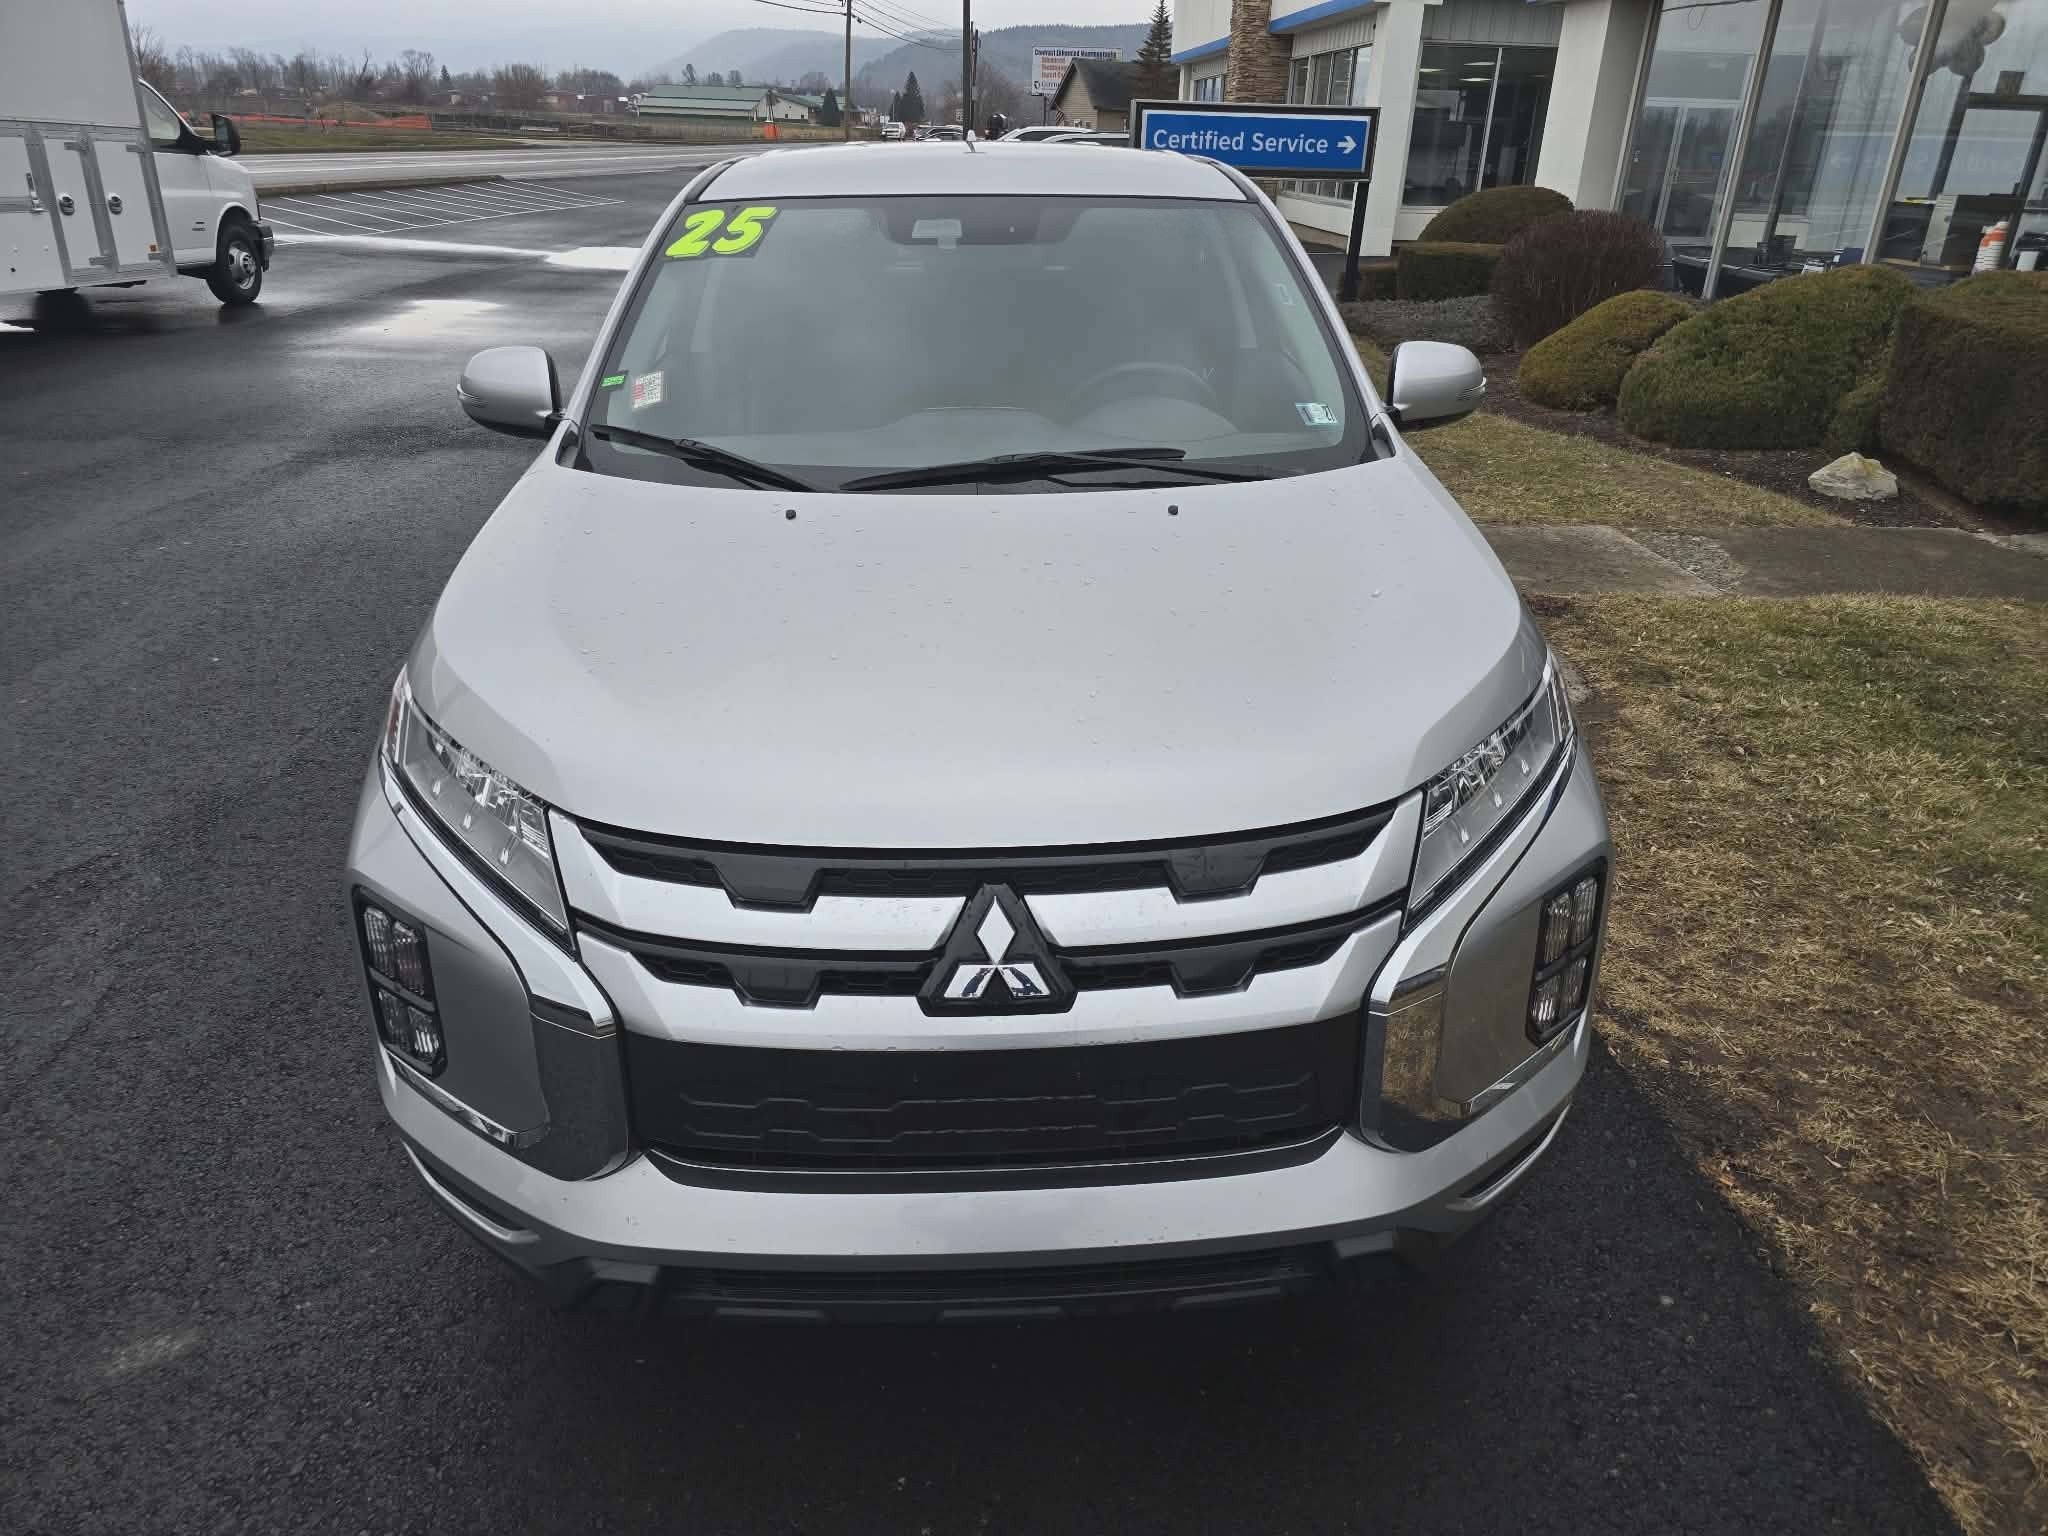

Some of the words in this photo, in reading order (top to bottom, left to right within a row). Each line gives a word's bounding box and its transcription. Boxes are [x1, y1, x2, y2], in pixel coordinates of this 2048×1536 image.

[1153, 129, 1245, 151] Certified
[1251, 132, 1328, 154] Service
[665, 206, 777, 258] 25
